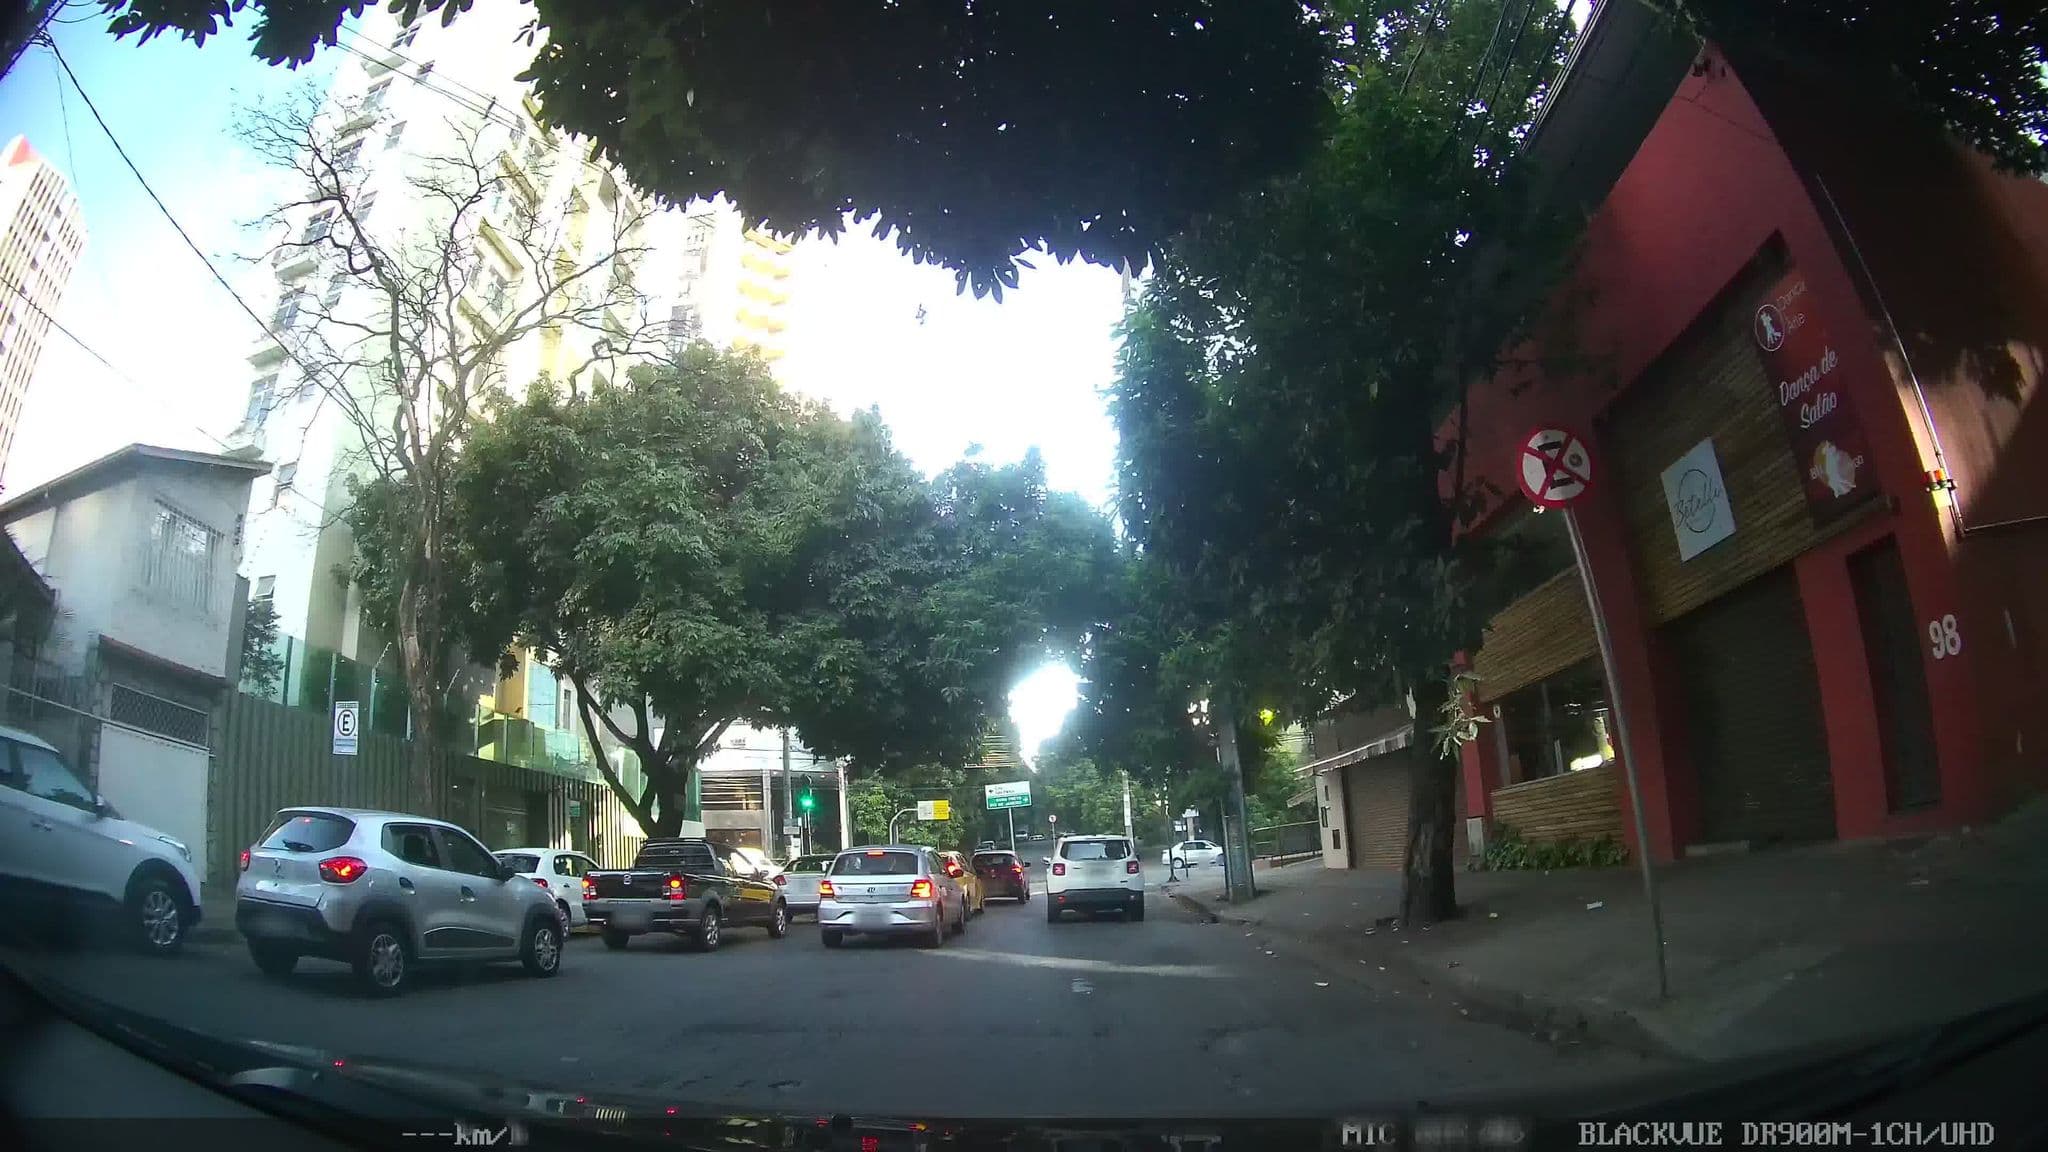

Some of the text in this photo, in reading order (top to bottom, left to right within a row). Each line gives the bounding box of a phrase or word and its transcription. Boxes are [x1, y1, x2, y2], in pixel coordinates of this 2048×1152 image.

[1779, 345, 1839, 406] Dança de
[1800, 391, 1838, 428] Salão
[1928, 614, 1961, 659] 98
[342, 713, 351, 732] E
